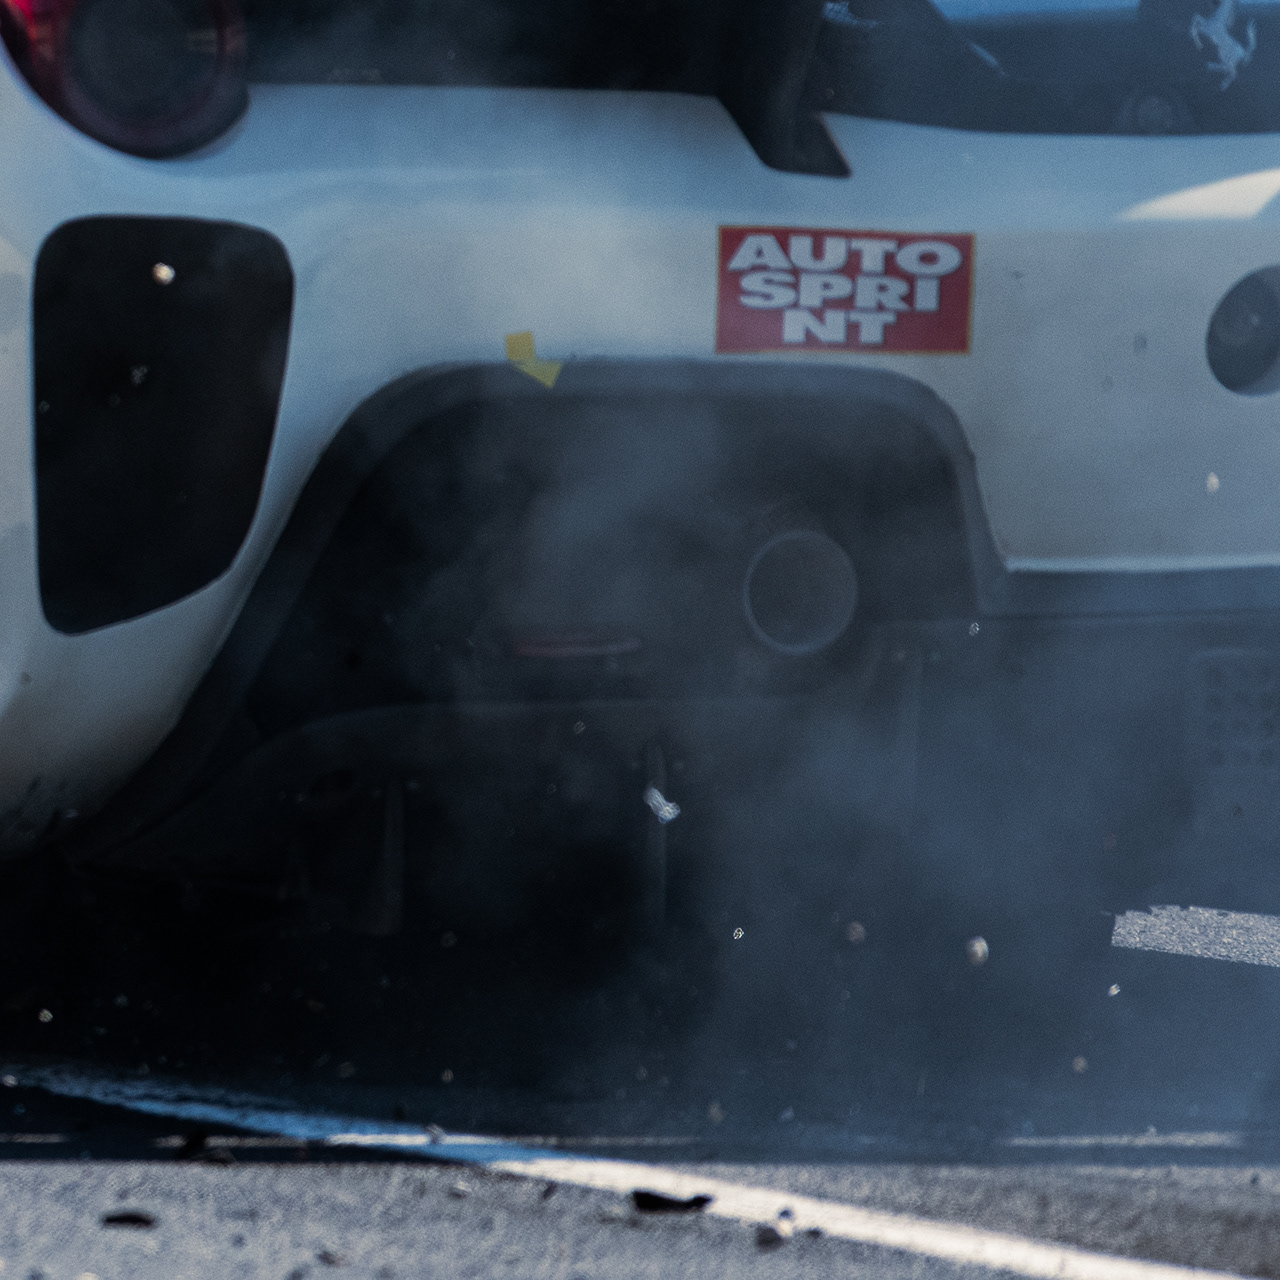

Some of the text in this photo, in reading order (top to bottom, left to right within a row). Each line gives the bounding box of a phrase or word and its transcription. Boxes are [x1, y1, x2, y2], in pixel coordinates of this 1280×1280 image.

[726, 233, 963, 277] AUTO
[739, 270, 940, 312] SPRI
[782, 308, 898, 345] NT
